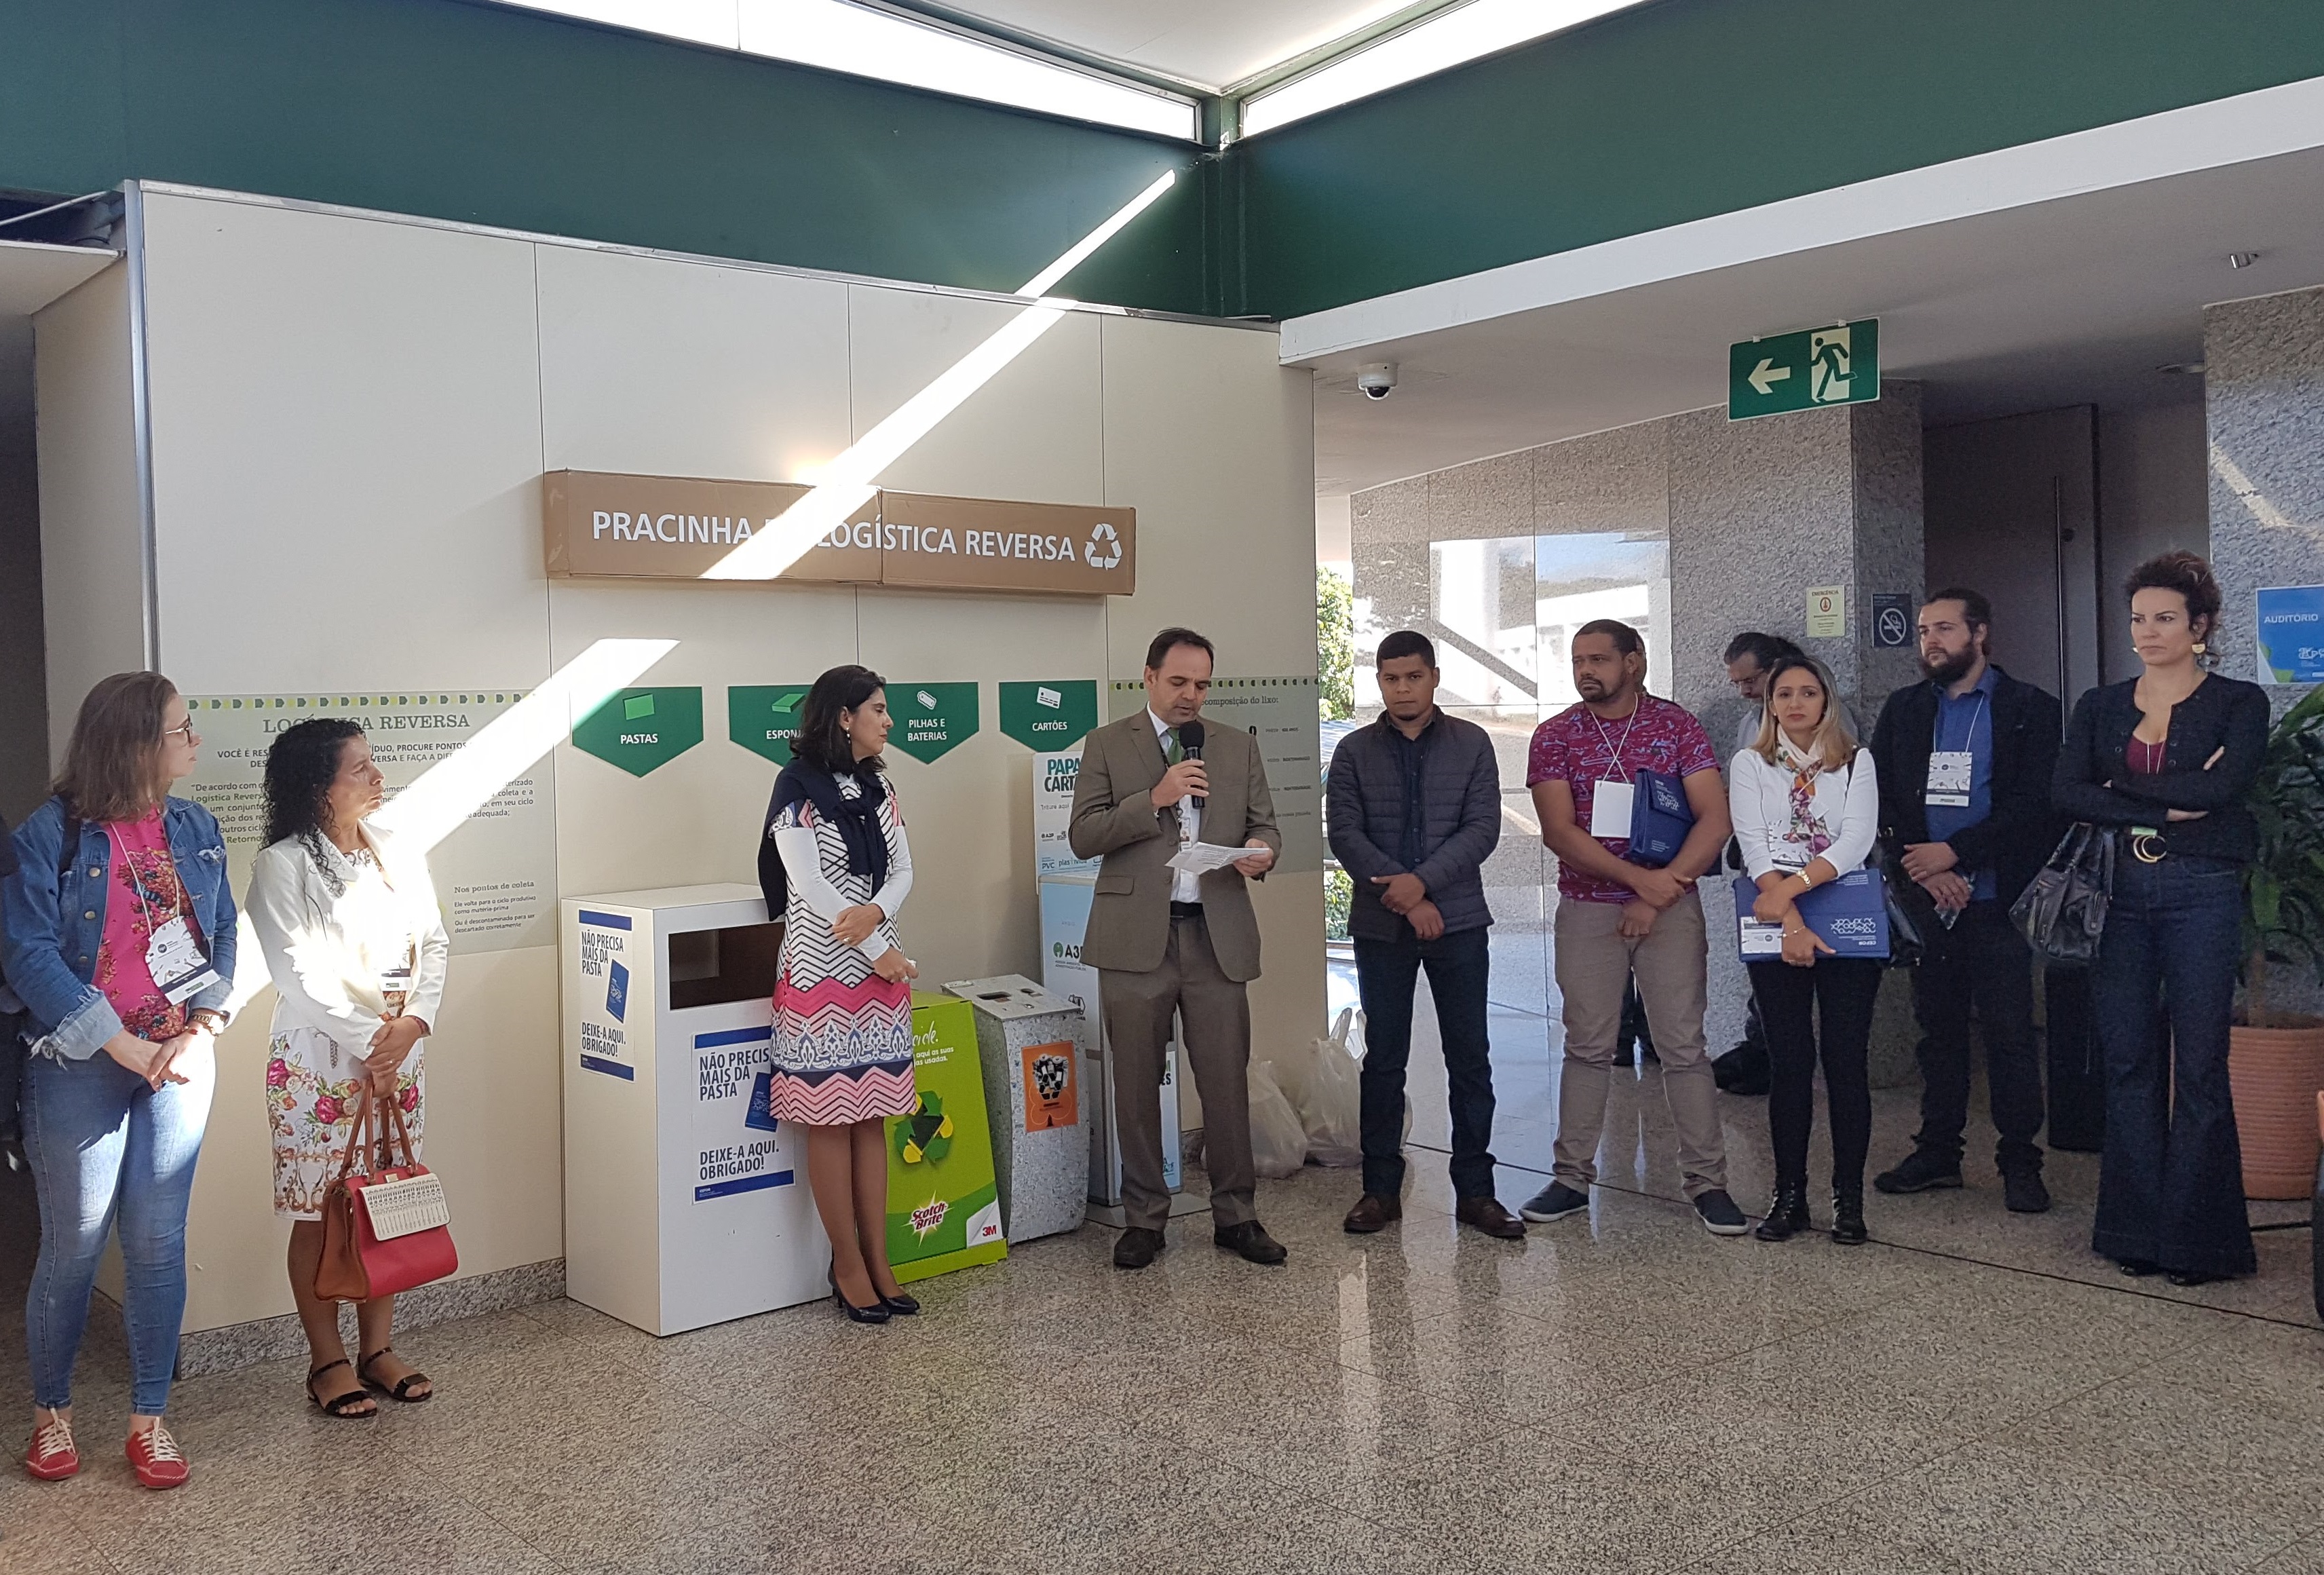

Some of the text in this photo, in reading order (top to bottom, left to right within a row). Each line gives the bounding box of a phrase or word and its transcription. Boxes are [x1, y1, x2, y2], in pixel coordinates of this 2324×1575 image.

[593, 510, 753, 544] PRACINHA
[816, 514, 1075, 562] OGÍSTICA REVERSA
[2264, 613, 2319, 624] AUDITÓRIO
[1261, 696, 1279, 704] lixo:
[379, 714, 470, 730] REVERSA
[909, 718, 945, 728] PILHAS E
[1032, 719, 1067, 732] CARTÕES
[620, 733, 658, 744] PASTAS
[766, 729, 802, 740] ESPONJ
[907, 731, 947, 742] BATERIAS
[217, 748, 242, 758] VOCÊ
[244, 748, 250, 757] É
[397, 743, 434, 751] PROCURE
[406, 754, 427, 763] FAÇA
[1047, 757, 1081, 776] PAPA
[208, 782, 237, 791] acordo
[1044, 774, 1076, 793] CART
[497, 789, 519, 797] coleta
[472, 809, 510, 818] adequada;
[219, 825, 246, 833] outros
[472, 884, 499, 894] pontos
[582, 929, 624, 953] NÃO PRECISA
[582, 945, 609, 964] MAIS DA
[582, 960, 603, 977] PASTA
[582, 1021, 626, 1045] DEIXE-A AQUI.
[582, 1036, 618, 1057] OBRIGADO!
[916, 1049, 931, 1059] aqui
[940, 1046, 954, 1055] suas
[700, 1047, 770, 1071] NÃO PRECIS
[924, 1055, 949, 1065] usadas.
[700, 1065, 750, 1086] MAIS DA
[700, 1082, 738, 1101] PASTA
[700, 1139, 780, 1166] DEIXE-A AQUI.
[700, 1156, 765, 1181] OBRIGADO!
[914, 1213, 943, 1230] Brite
[982, 1225, 997, 1237] 3M
